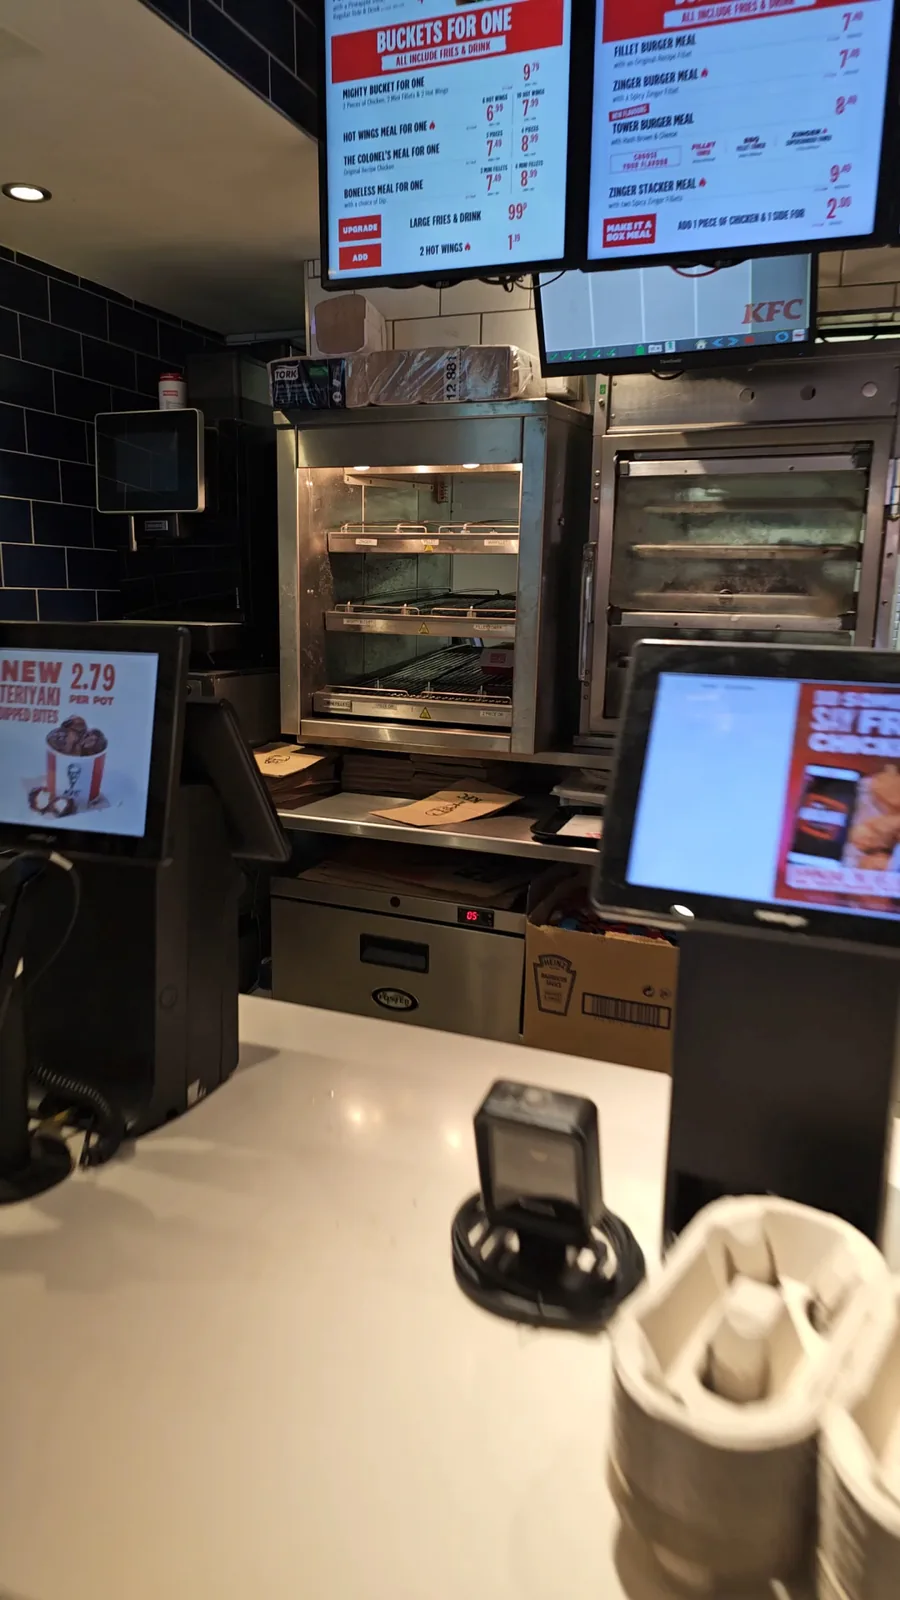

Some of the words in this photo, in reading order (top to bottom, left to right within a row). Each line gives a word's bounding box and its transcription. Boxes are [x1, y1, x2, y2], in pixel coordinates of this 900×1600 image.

[376, 20, 443, 54] BUCKETS
[447, 14, 477, 41] FOR
[481, 7, 512, 35] ONE
[395, 54, 408, 67] ALL
[409, 51, 438, 64] INCLUDE
[439, 47, 459, 60] FRIES
[461, 45, 466, 55] &
[468, 40, 491, 54] DRINK
[613, 42, 639, 57] FILLET
[640, 37, 674, 54] BURGER
[675, 33, 697, 49] MEAL
[343, 86, 368, 100] MIGHTY
[369, 81, 395, 96] BUCKET
[396, 78, 410, 92] FOR
[411, 76, 425, 89] ONE
[612, 77, 641, 92] ZINGER
[643, 71, 676, 87] BURGER
[677, 67, 699, 83] MEAL
[343, 131, 356, 143] HOT
[357, 127, 379, 140] WINGS
[380, 124, 397, 137] MEAL
[399, 122, 413, 134] FOR
[413, 120, 428, 132] ONE
[612, 120, 639, 135] TOWER
[640, 115, 672, 131] BURGER
[673, 112, 695, 126] MEAL
[343, 154, 356, 167] THE
[357, 150, 392, 165] COLONEL'S
[392, 147, 410, 160] MEAL
[411, 145, 425, 158] FOR
[426, 142, 440, 155] ONE
[343, 185, 376, 200] BONELESS
[377, 182, 394, 196] MEAL
[395, 181, 409, 194] FOR
[410, 178, 424, 192] ONE
[608, 184, 637, 199] ZINGER
[638, 180, 674, 196] STACKER
[675, 177, 697, 192] MEAL
[342, 222, 379, 235] UPGRADE
[409, 216, 431, 229] LARGE
[432, 214, 451, 227] FRIES
[452, 213, 458, 224] &
[459, 210, 482, 224] DRINK
[606, 223, 632, 234] MAKE
[632, 221, 644, 231] IT
[644, 220, 653, 230] A
[677, 220, 692, 231] ADD
[697, 216, 718, 229] PIECE
[729, 211, 760, 226] CHICKEN
[606, 231, 626, 243] BOX
[626, 229, 652, 241] MEAL
[352, 253, 369, 263] ADD
[419, 246, 425, 257] 2
[425, 244, 439, 256] HOT
[441, 242, 463, 254] WINGS
[741, 297, 804, 325] KFC
[275, 369, 297, 380] TORK
[1, 660, 63, 684] NEW
[70, 662, 116, 692] 2.79
[0, 684, 61, 707] TERIYAKI
[69, 694, 90, 705] PER
[92, 695, 115, 706] POT
[32, 708, 59, 724] BITES
